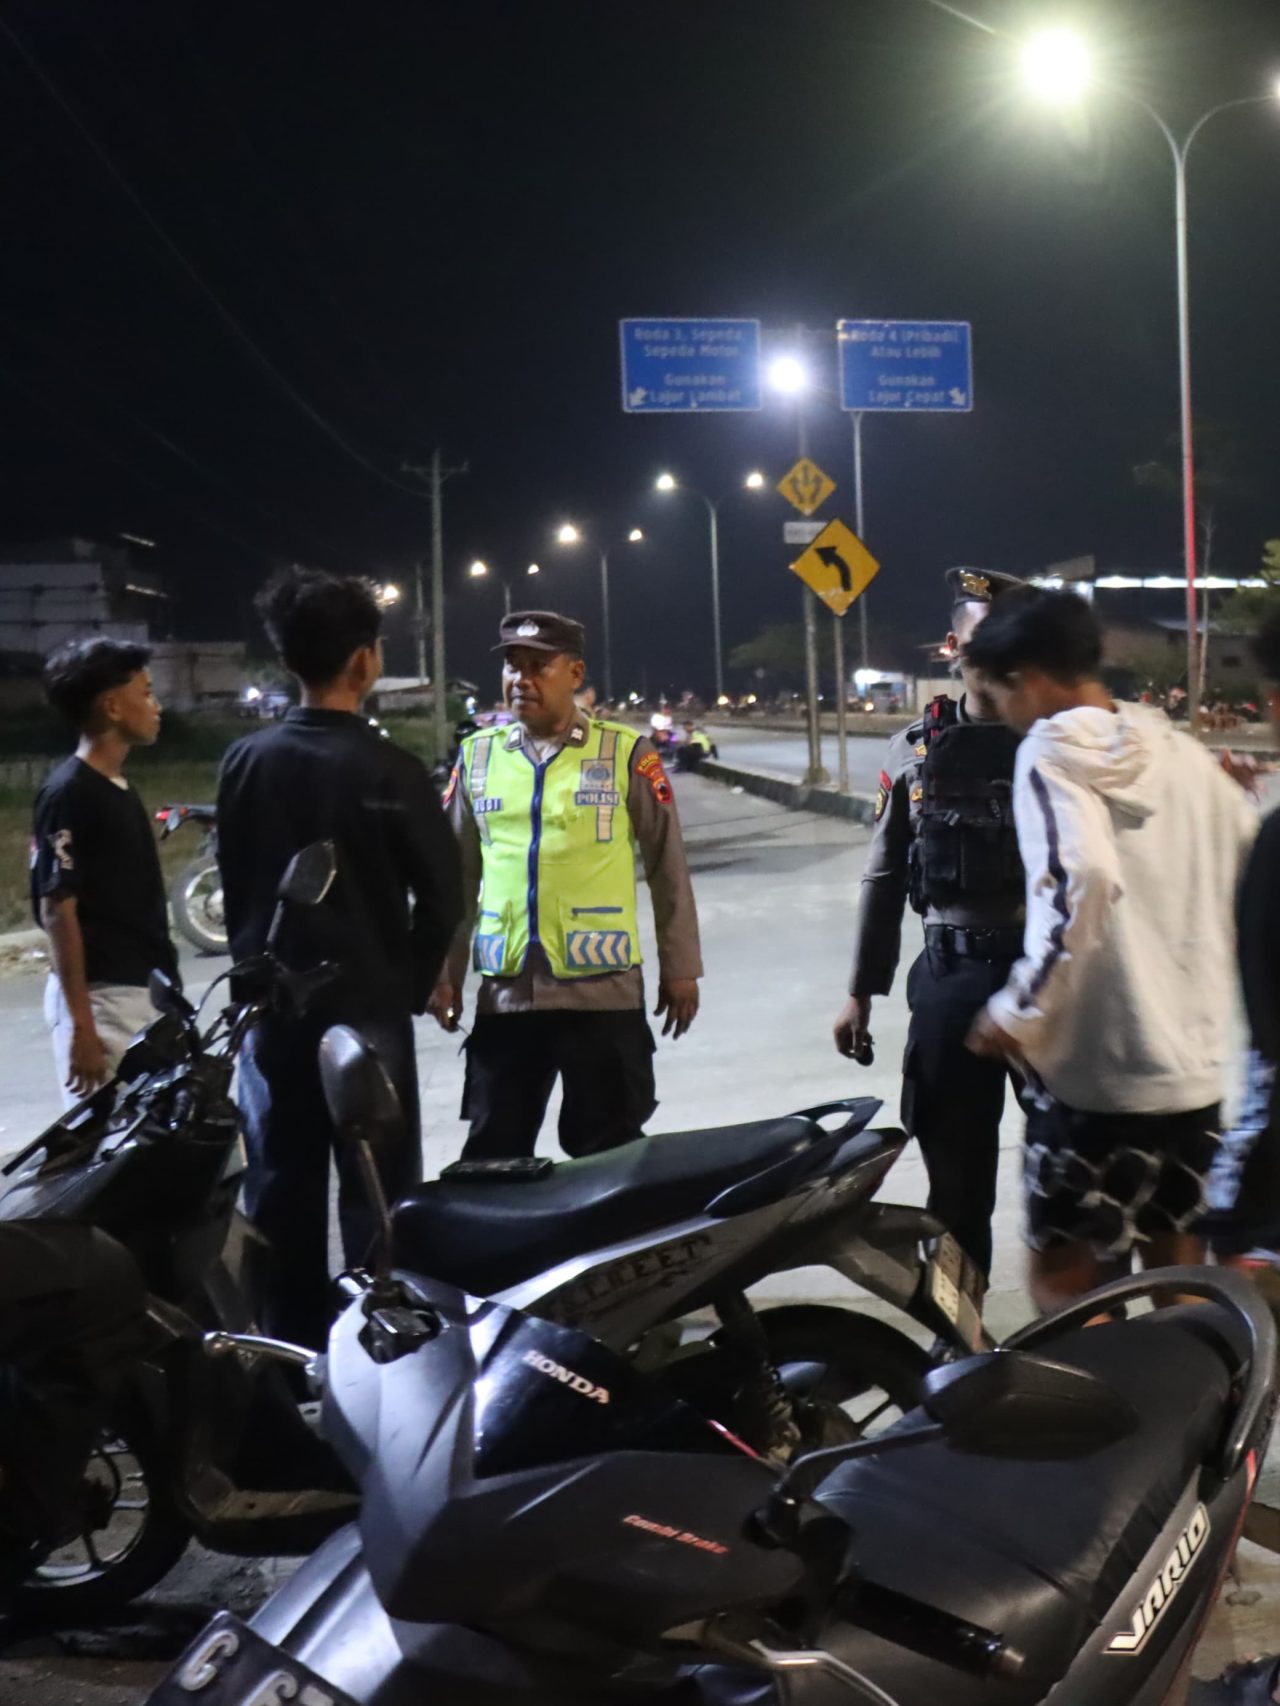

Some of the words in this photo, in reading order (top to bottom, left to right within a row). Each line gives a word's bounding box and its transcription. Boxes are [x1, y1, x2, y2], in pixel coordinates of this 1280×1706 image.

[576, 792, 618, 804] POLISI
[522, 1349, 609, 1404] HONDA
[1104, 1503, 1209, 1653] VARIO
